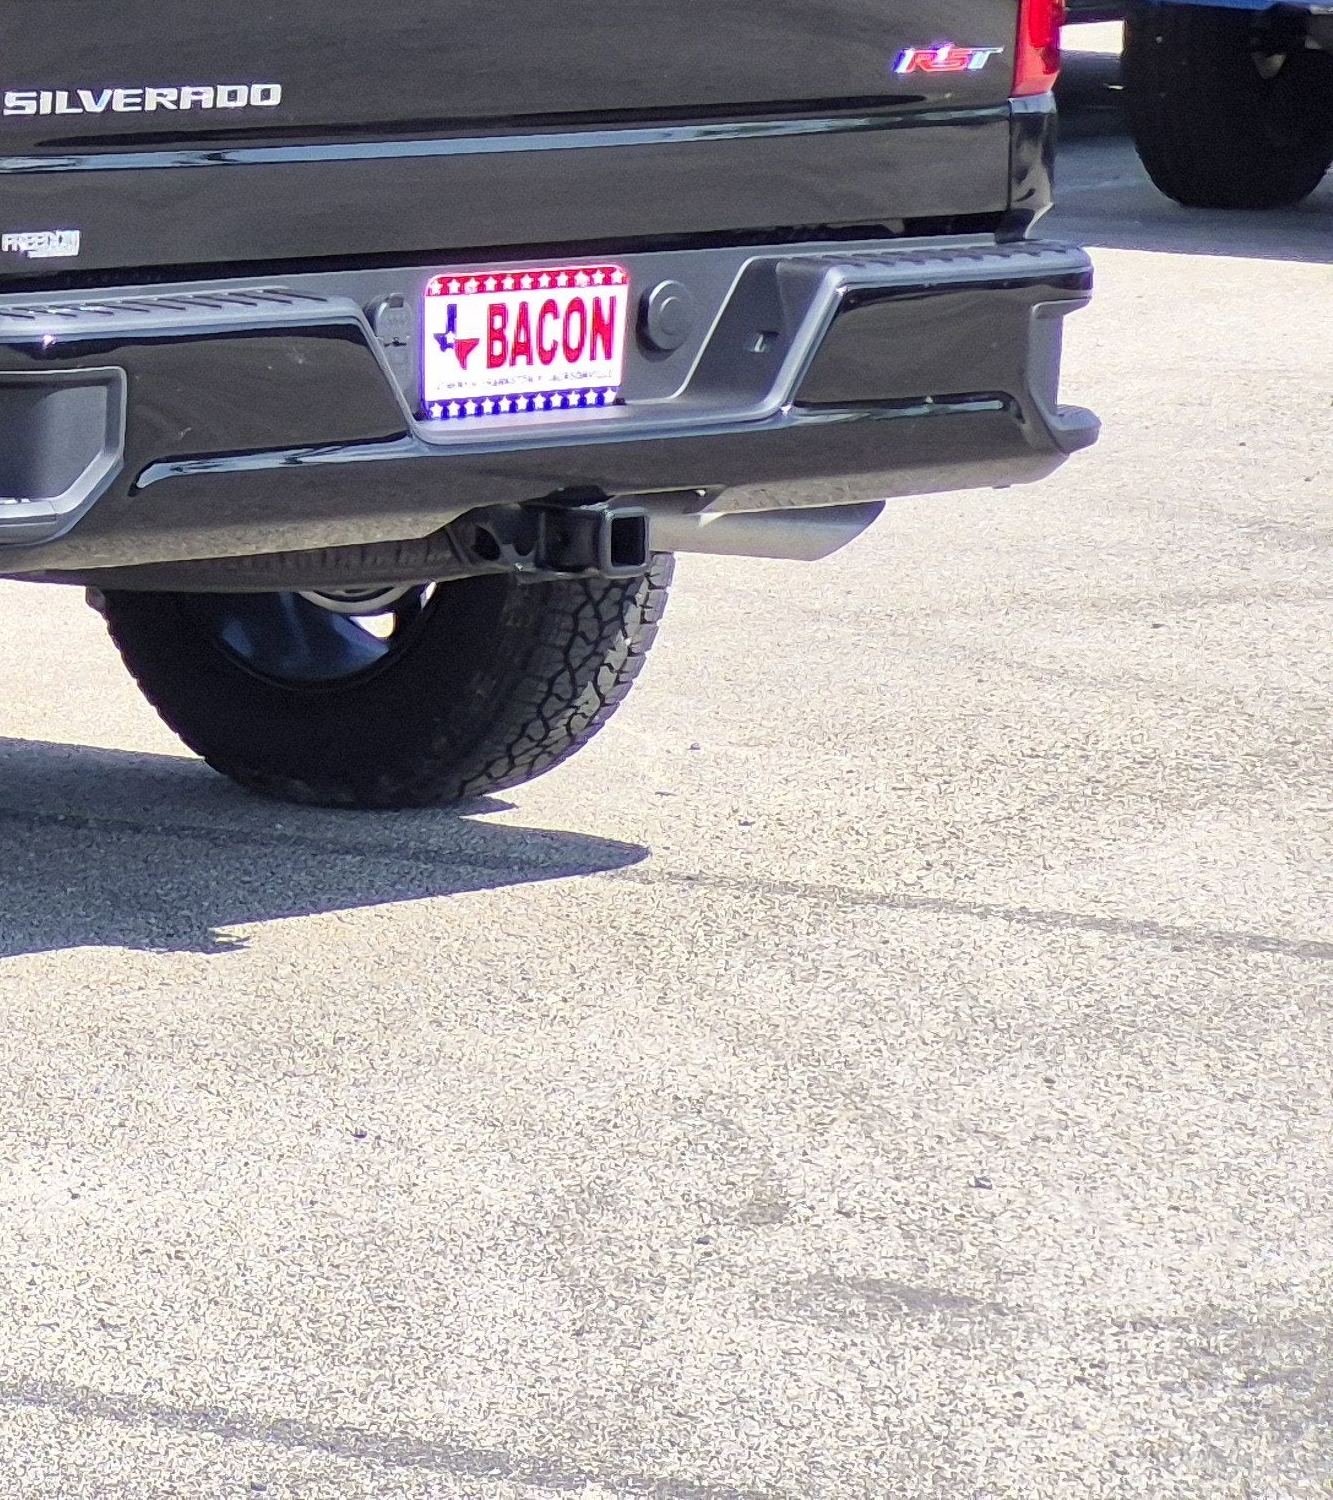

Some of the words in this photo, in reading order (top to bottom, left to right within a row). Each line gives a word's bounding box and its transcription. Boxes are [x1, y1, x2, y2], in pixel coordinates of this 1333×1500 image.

[893, 42, 1005, 74] RST
[2, 83, 282, 116] SILVERADO
[485, 295, 617, 370] BACON
